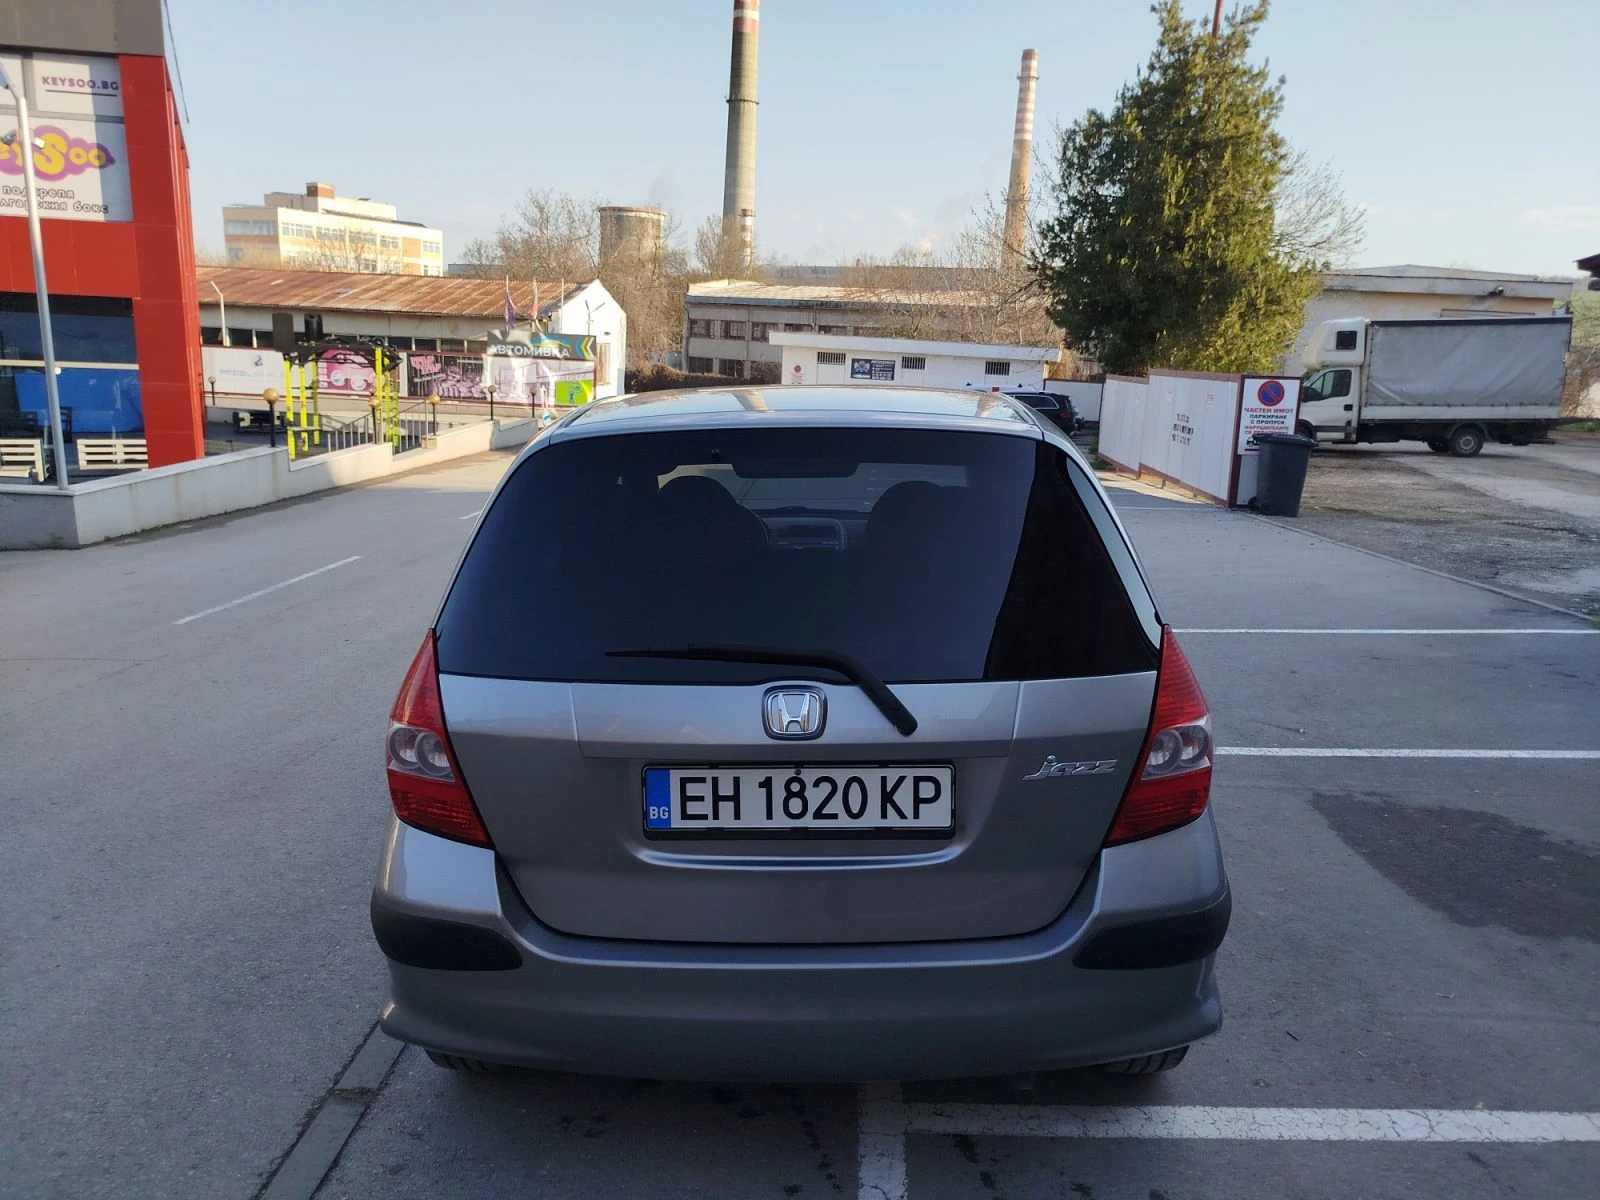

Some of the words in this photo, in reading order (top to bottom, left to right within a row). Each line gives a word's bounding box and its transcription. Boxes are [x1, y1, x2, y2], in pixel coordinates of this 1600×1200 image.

[42, 76, 119, 90] KEYSOO.BG
[2, 185, 74, 199] подрепя
[73, 201, 109, 213] бокс
[490, 344, 570, 357] АВТОМИВКА
[1022, 754, 1118, 780] jazz
[649, 806, 669, 819] BG
[679, 776, 741, 821] EH
[758, 775, 869, 821] 1820
[880, 775, 942, 820] KP
